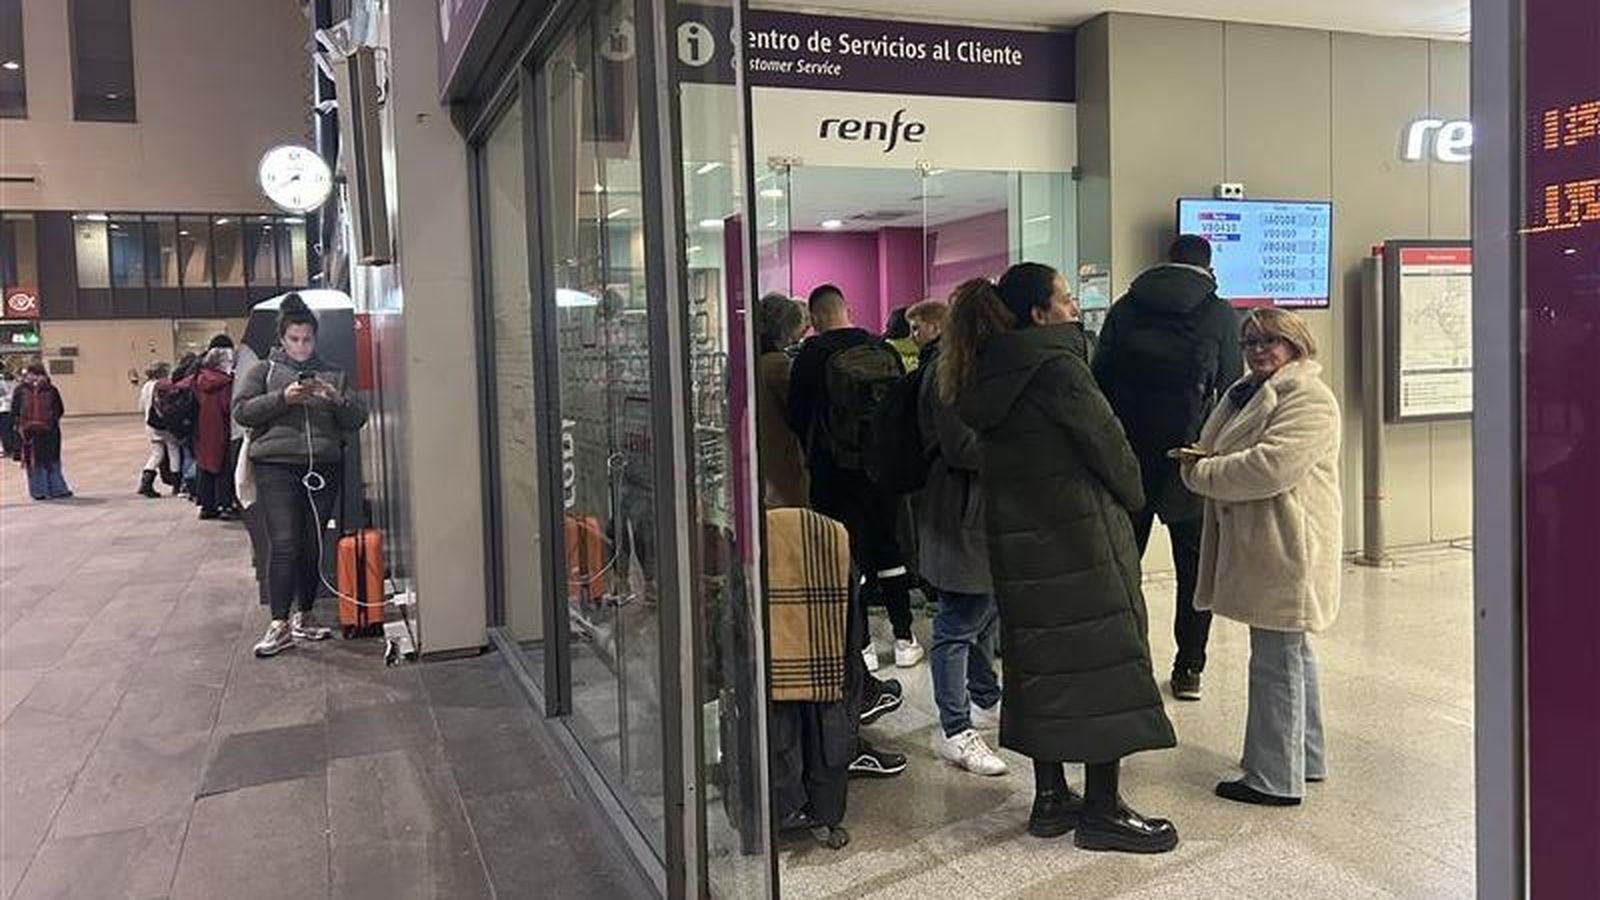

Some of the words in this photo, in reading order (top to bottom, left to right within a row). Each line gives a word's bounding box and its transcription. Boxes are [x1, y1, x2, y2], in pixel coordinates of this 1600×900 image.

[807, 32, 832, 53] de
[839, 33, 927, 60] Servicios
[933, 38, 951, 61] al
[958, 41, 1022, 66] Cliente
[730, 58, 792, 74] stomer
[796, 60, 842, 76] Service
[819, 108, 926, 153] renfe
